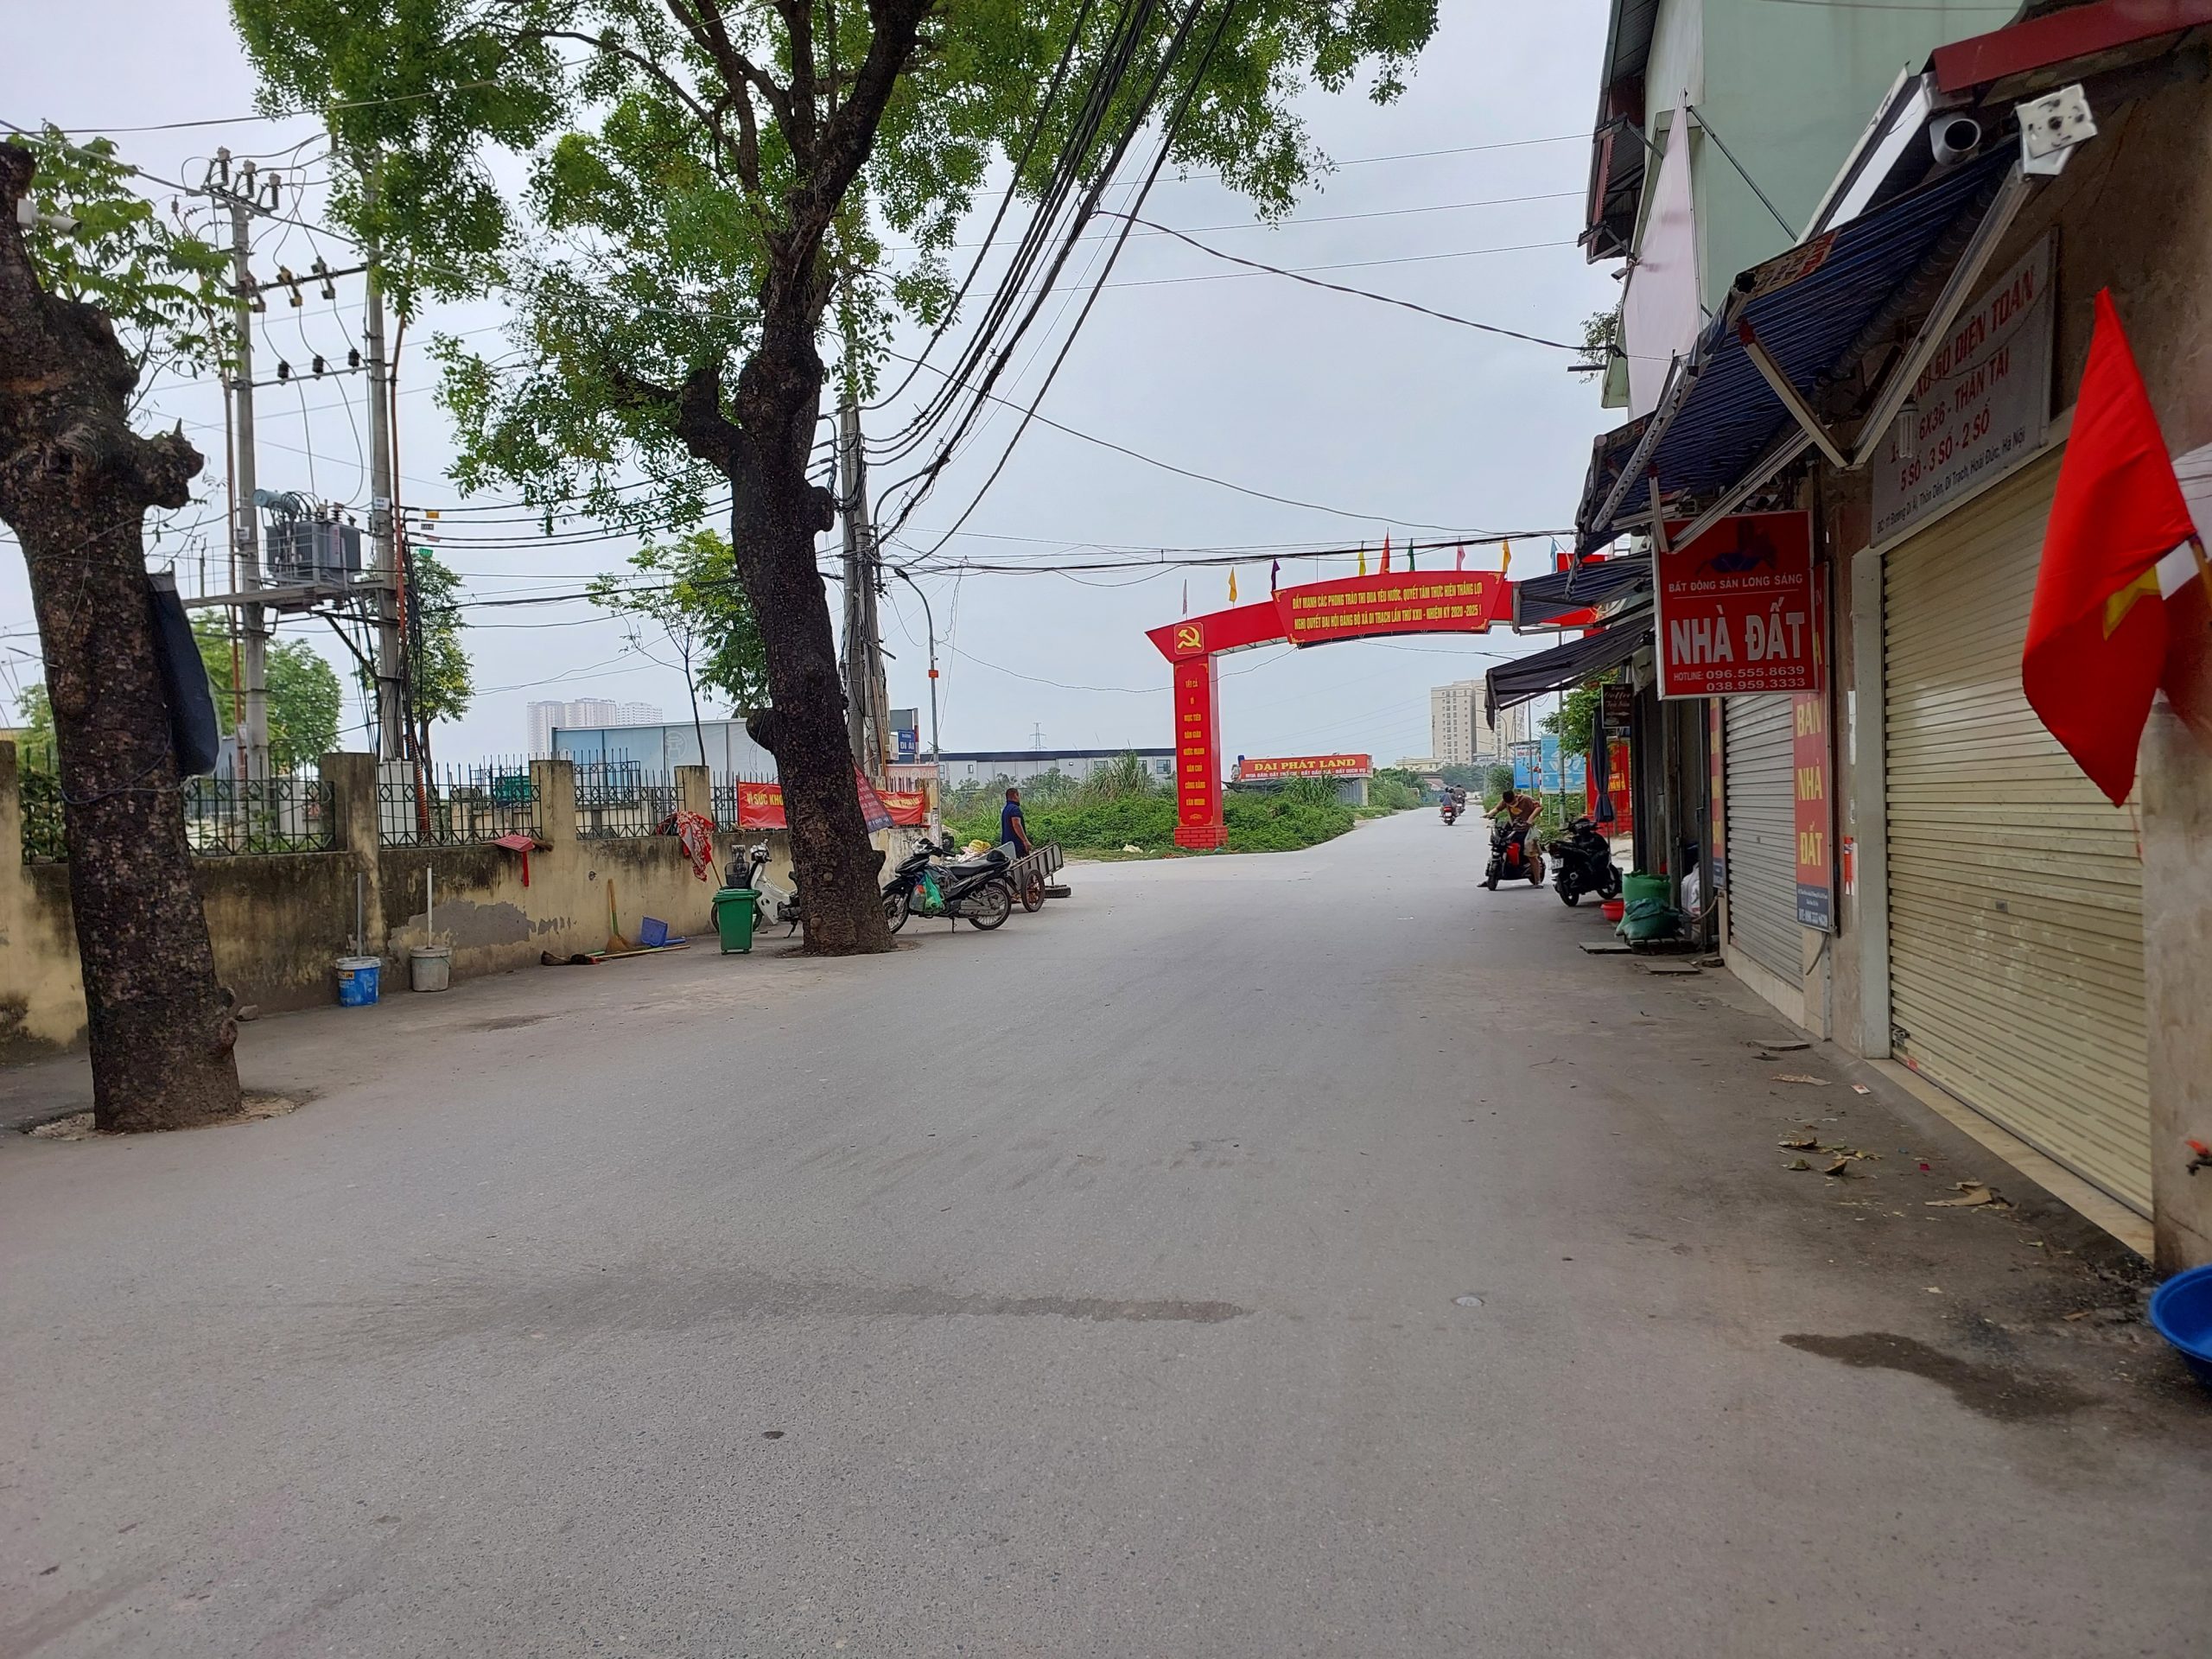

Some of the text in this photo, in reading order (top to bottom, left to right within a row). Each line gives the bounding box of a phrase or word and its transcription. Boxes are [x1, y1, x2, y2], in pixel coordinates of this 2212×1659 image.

[1919, 401, 1945, 441] 6X36
[1901, 469, 1906, 491] 5
[1909, 449, 1922, 486] SỐ
[1929, 448, 1936, 471] 3
[1939, 426, 1953, 465] SỐ
[1962, 423, 1970, 449] 2
[1974, 397, 1991, 441] SỐ
[1318, 594, 1327, 607] CÁC
[1328, 594, 1344, 607] PHONG
[1377, 588, 1387, 602] YÊU
[1474, 582, 1483, 598] LỢI
[1669, 576, 1688, 593] BẤT
[1690, 578, 1716, 594] ĐỘNG
[1742, 575, 1770, 588] LONG
[1451, 606, 1464, 619] 2020
[1670, 605, 1734, 665] NHÀ
[1745, 597, 1805, 662] ĐẤT
[1673, 665, 1805, 682] HOTLINE: 096.555.8639
[1706, 678, 1806, 692] 038.959.3333
[1255, 758, 1356, 772] ĐẠI PHÁT LAND
[1798, 759, 1823, 801] NHÀ
[747, 791, 753, 804] VÌ
[753, 792, 768, 805] SỨC
[1800, 822, 1823, 866] ĐẤT
